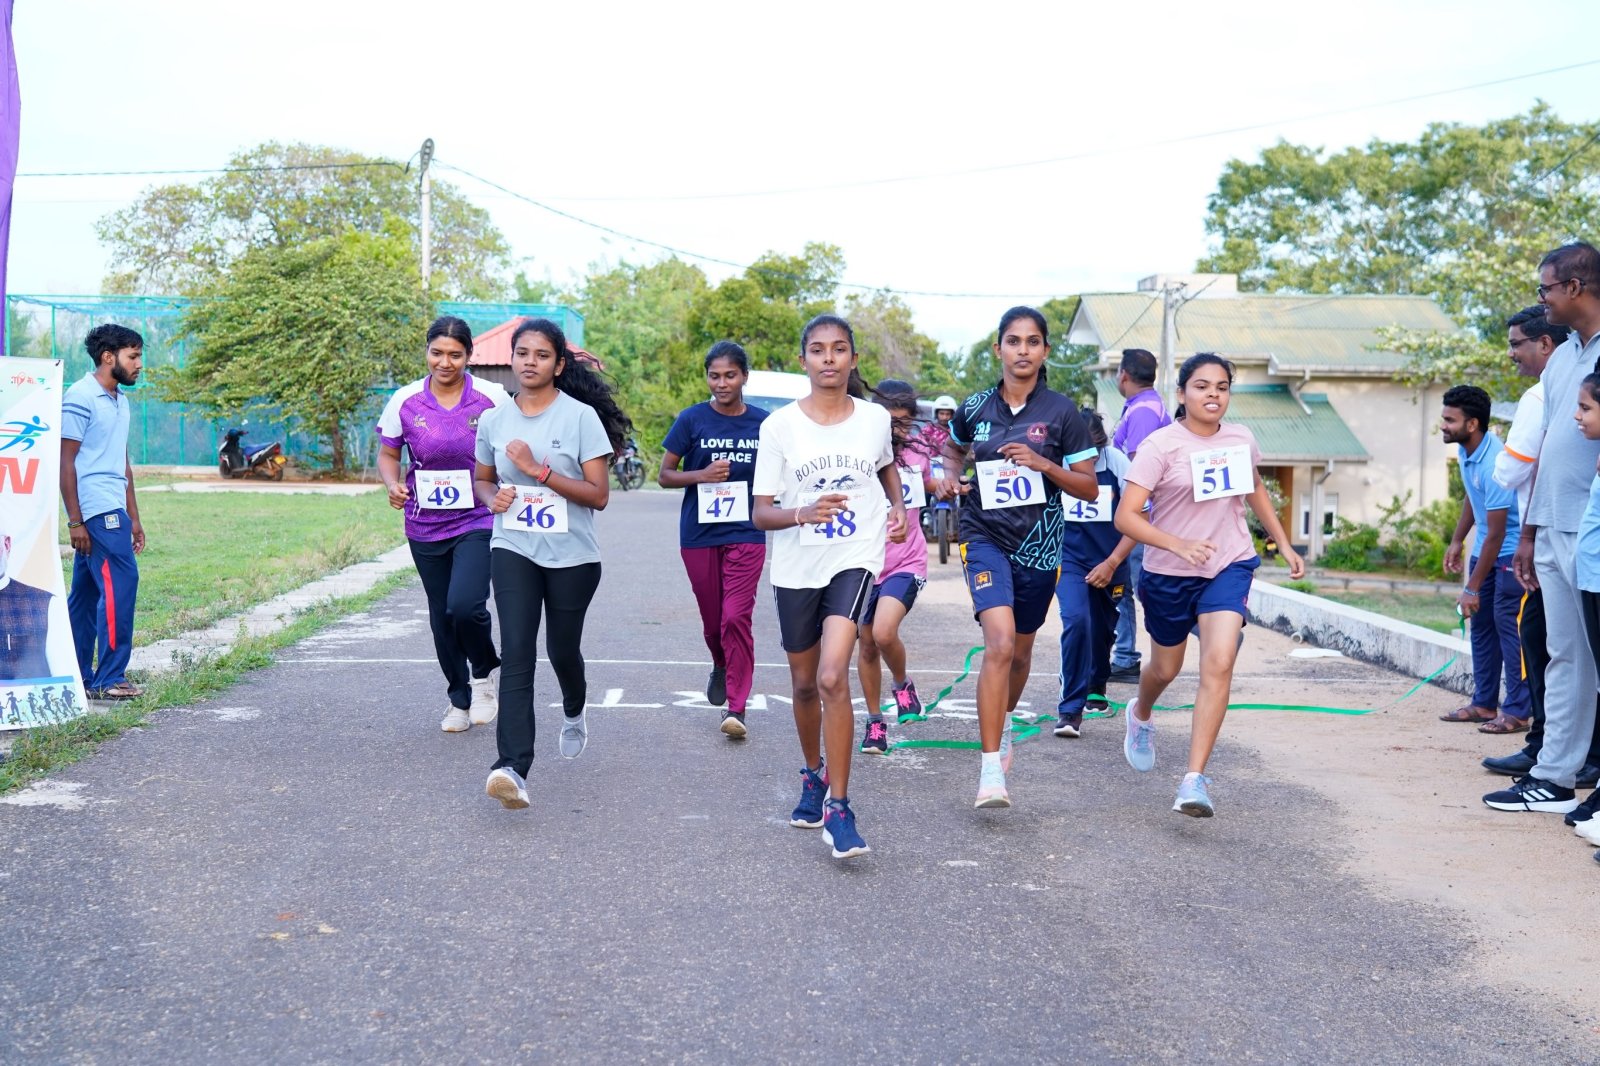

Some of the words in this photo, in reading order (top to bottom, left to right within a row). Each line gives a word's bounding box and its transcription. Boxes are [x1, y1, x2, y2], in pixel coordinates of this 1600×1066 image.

[700, 438, 733, 449] LOVE
[711, 452, 752, 463] PEACE
[1210, 458, 1227, 466] RUN
[795, 455, 831, 482] BONDI
[836, 455, 874, 478] BEACH
[999, 469, 1018, 477] RUN
[995, 476, 1032, 504] 50
[1202, 466, 1235, 494] 51
[427, 486, 460, 506] 49
[517, 504, 555, 529] 46
[706, 497, 736, 518] 47
[1069, 500, 1099, 519] 45
[814, 510, 857, 539] 48
